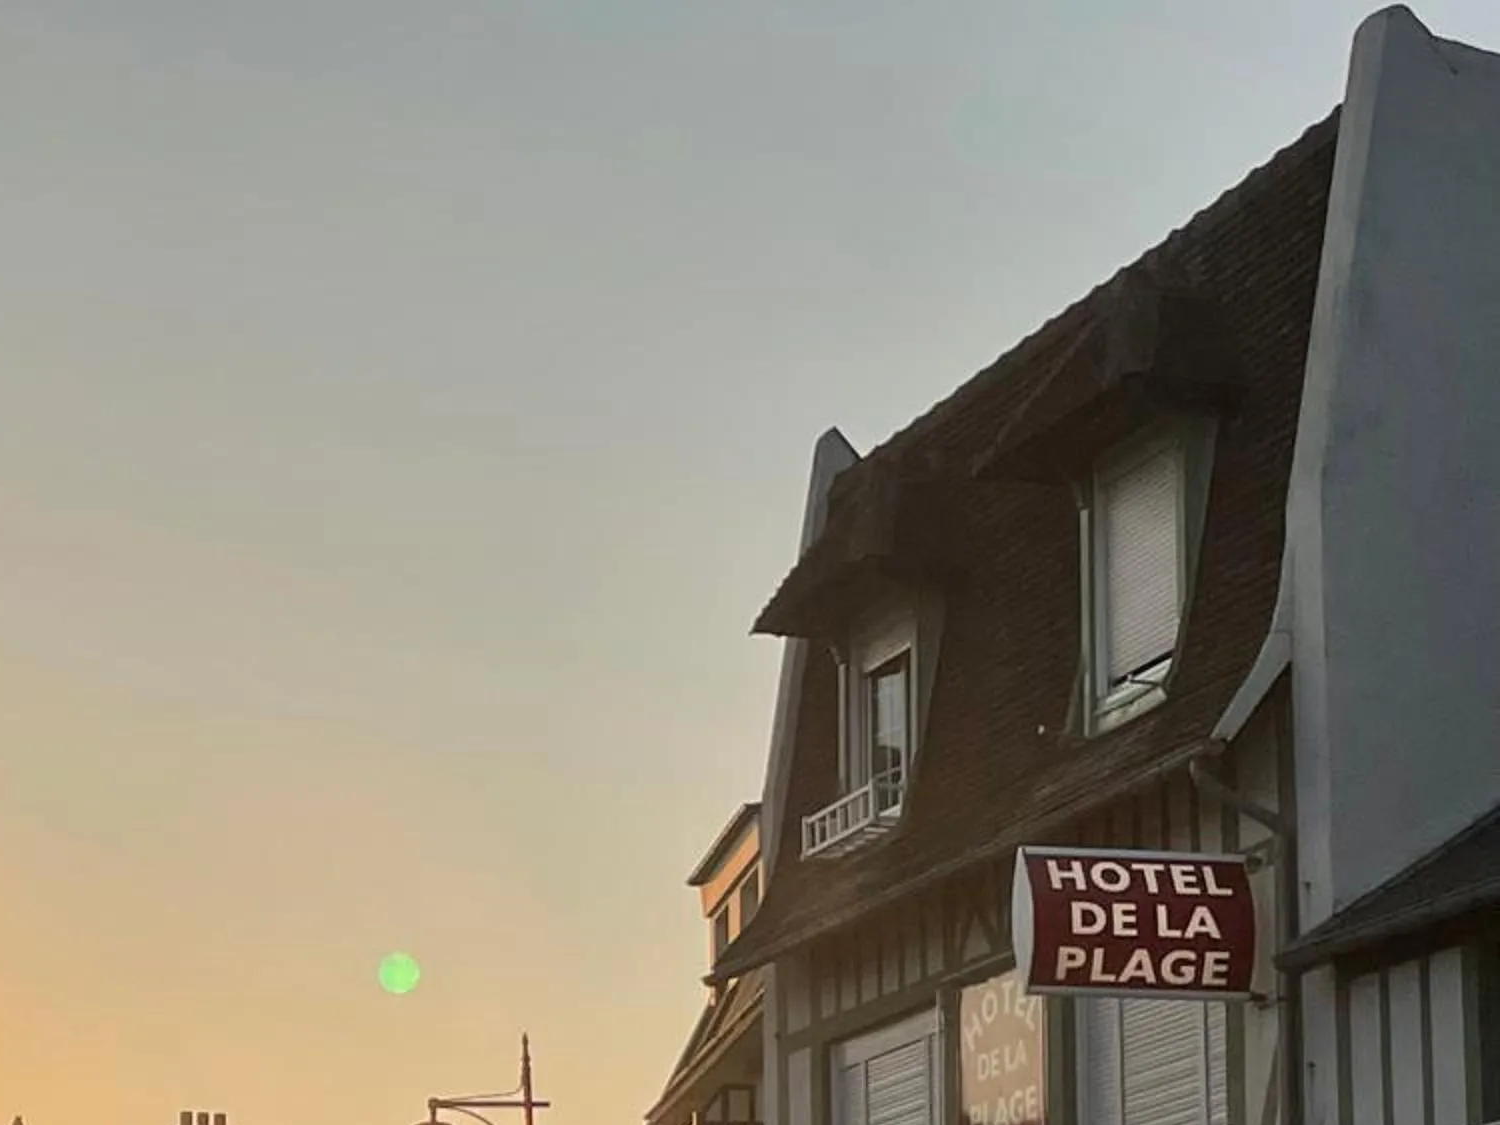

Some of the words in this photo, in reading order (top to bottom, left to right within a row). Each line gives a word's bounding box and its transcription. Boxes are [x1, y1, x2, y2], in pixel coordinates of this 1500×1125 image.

[1047, 859, 1233, 896] HOTEL
[1071, 901, 1138, 937] DE
[1156, 904, 1221, 940] LA
[1055, 946, 1231, 986] PLAGE
[963, 978, 1035, 1050] HOTEL
[977, 1049, 1000, 1080] DE
[1004, 1040, 1027, 1071] LA
